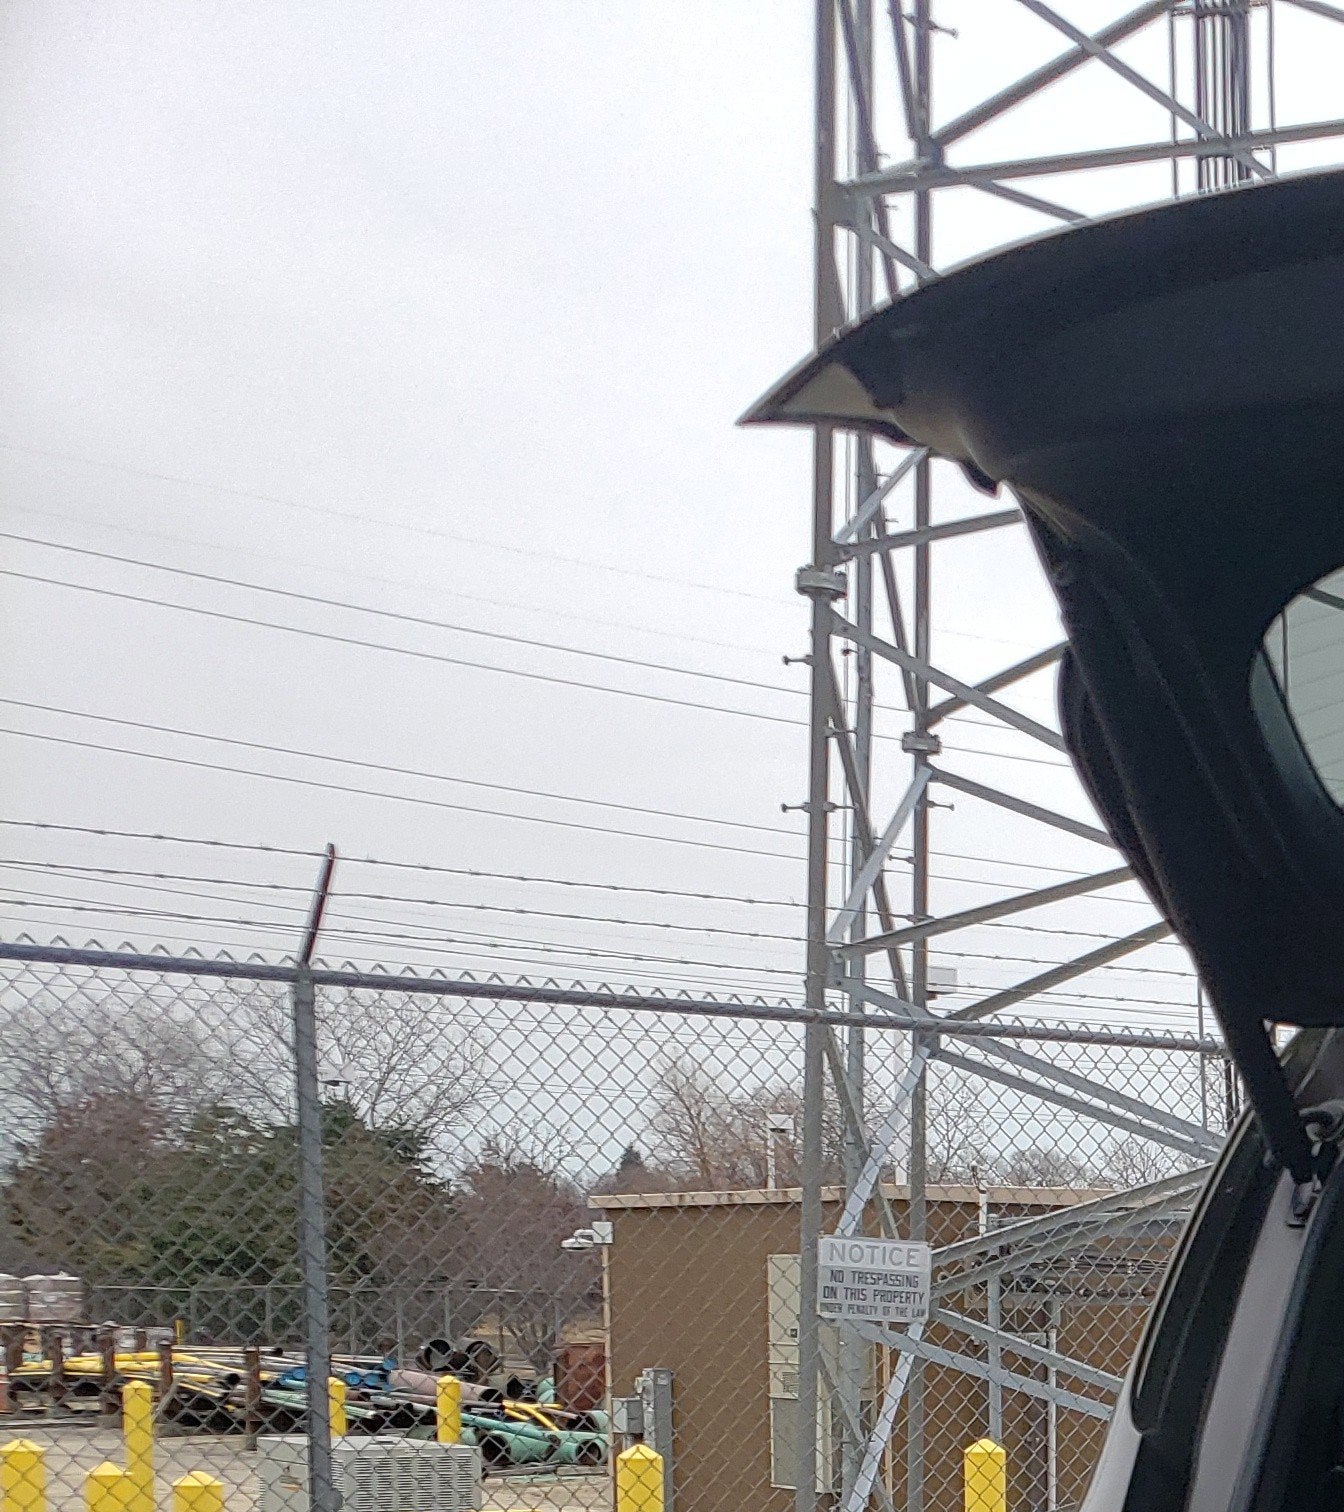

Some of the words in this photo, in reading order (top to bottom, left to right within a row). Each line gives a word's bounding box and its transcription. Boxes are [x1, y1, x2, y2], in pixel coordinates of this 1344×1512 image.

[829, 1242, 921, 1267] NOTICE
[830, 1270, 844, 1283] NO
[851, 1270, 919, 1288] TRESPASSING
[823, 1285, 838, 1299] ON
[844, 1287, 867, 1301] THIS
[873, 1289, 925, 1305] PROPERTY
